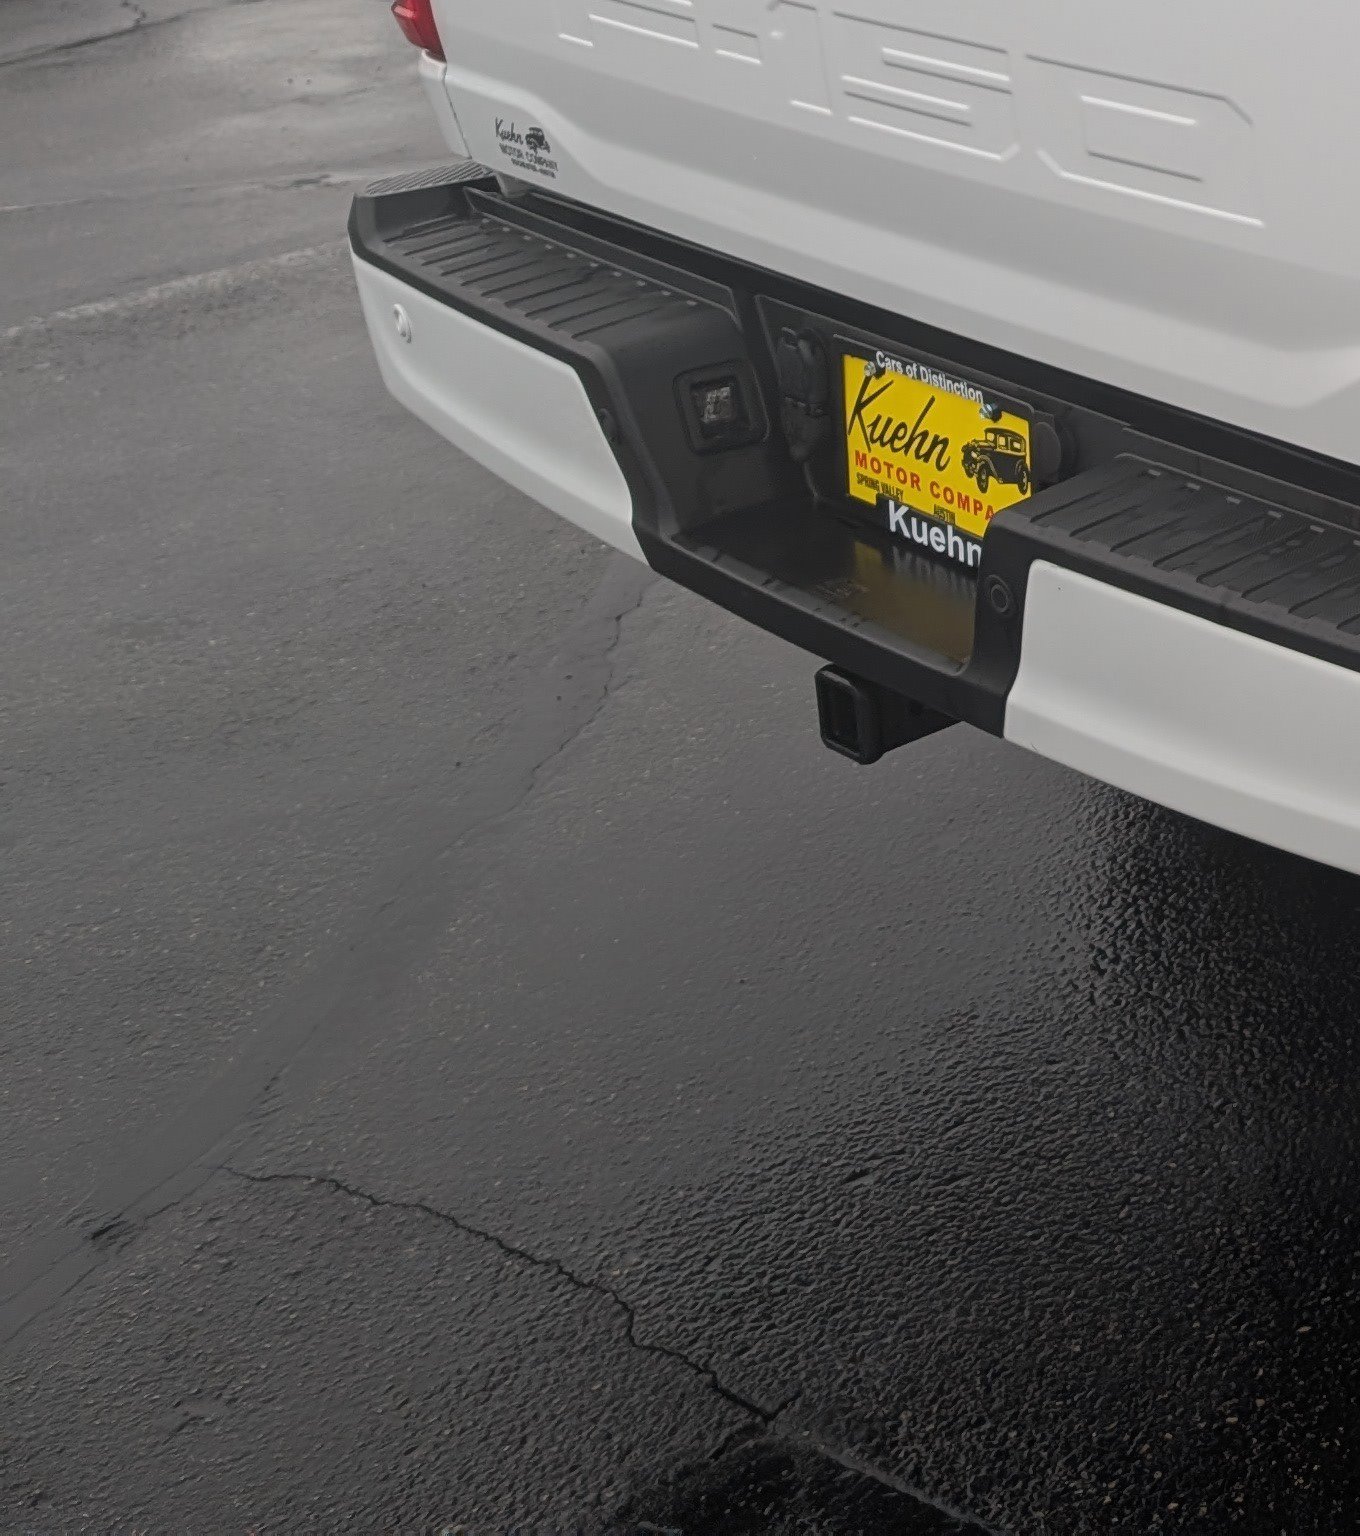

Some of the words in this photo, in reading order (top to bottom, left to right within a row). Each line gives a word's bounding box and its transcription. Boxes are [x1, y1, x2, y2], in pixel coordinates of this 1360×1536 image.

[875, 350, 904, 375] Cars
[905, 362, 919, 380] of
[919, 367, 984, 406] Distinction
[848, 372, 951, 472] Kuehn
[854, 450, 921, 492] MOTOR
[856, 472, 880, 492] SPRING
[888, 499, 983, 568] Kuehn
